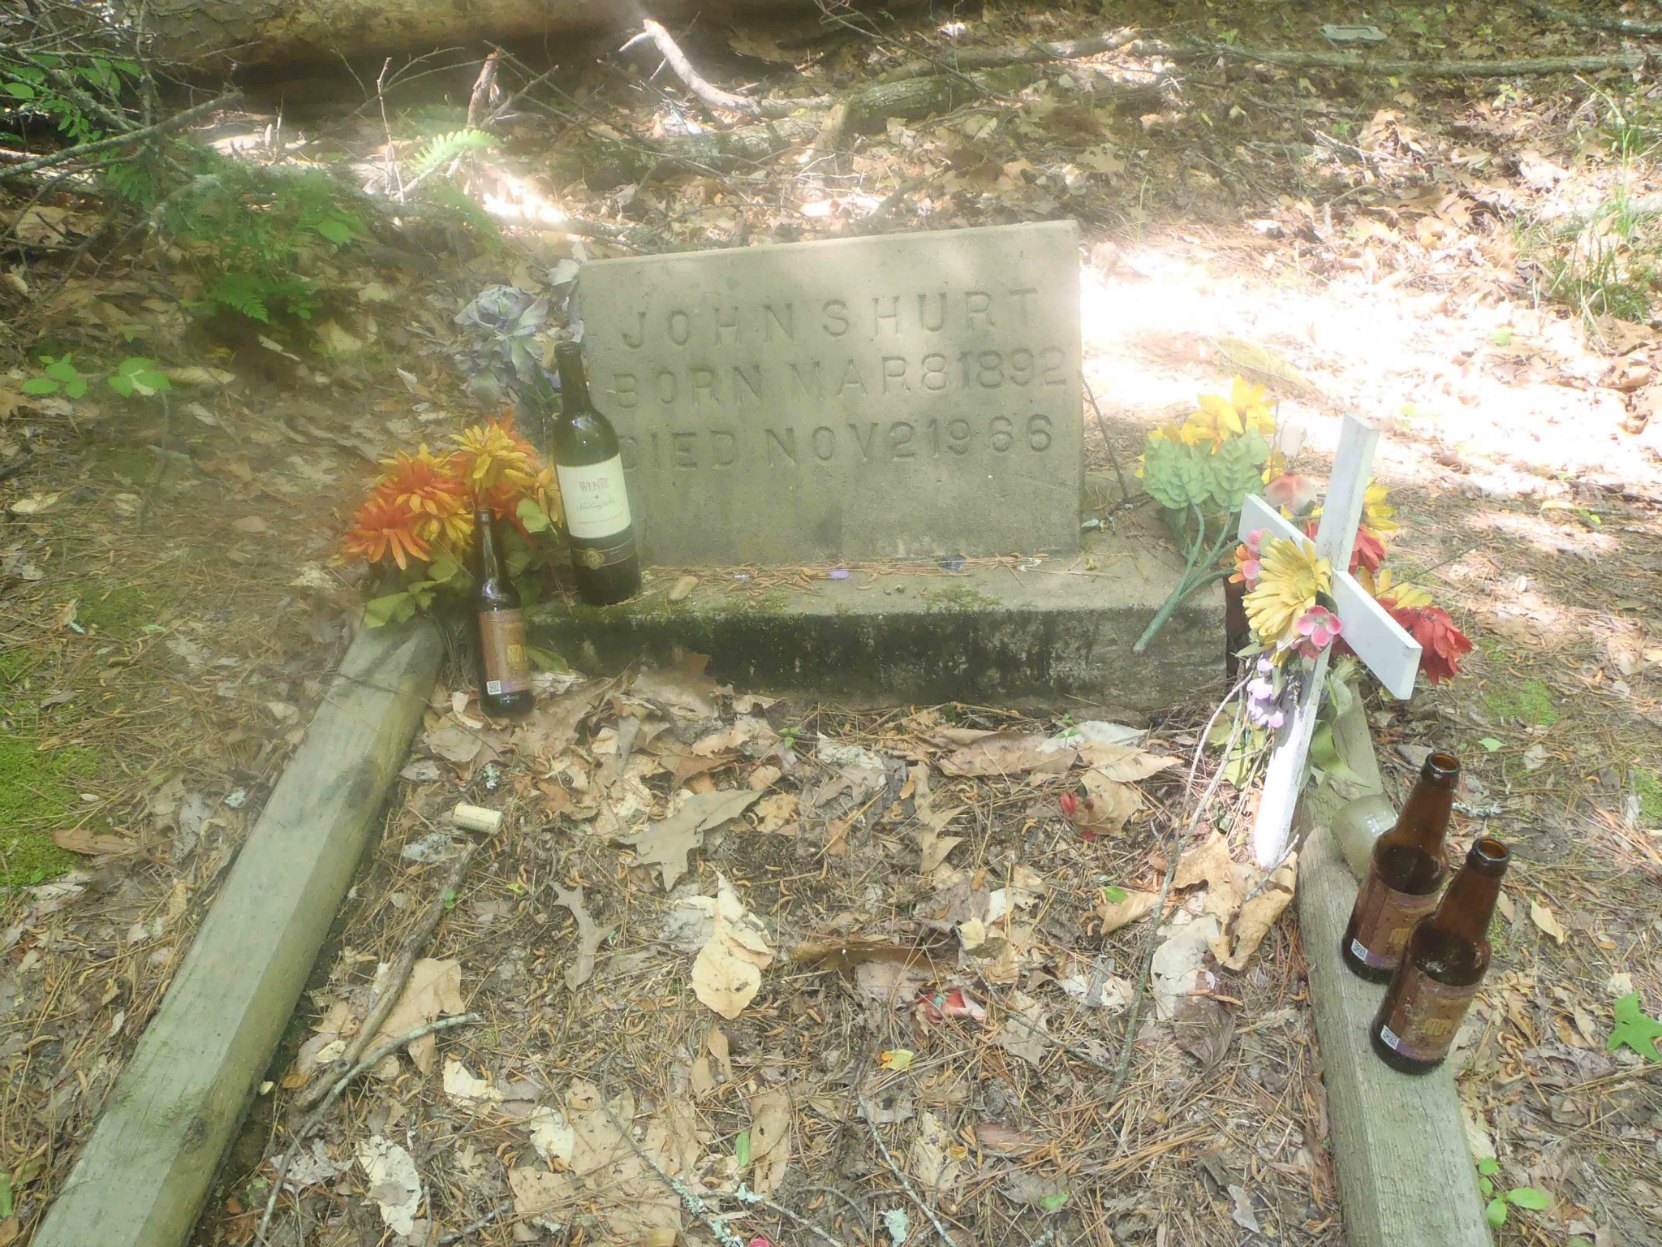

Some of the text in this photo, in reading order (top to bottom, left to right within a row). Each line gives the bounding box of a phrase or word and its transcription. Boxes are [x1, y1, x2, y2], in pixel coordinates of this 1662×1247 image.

[621, 303, 793, 349] JOHN
[614, 365, 763, 408] BORN
[789, 354, 911, 401] MAR
[618, 429, 738, 469] DIED
[764, 422, 879, 467] NOV
